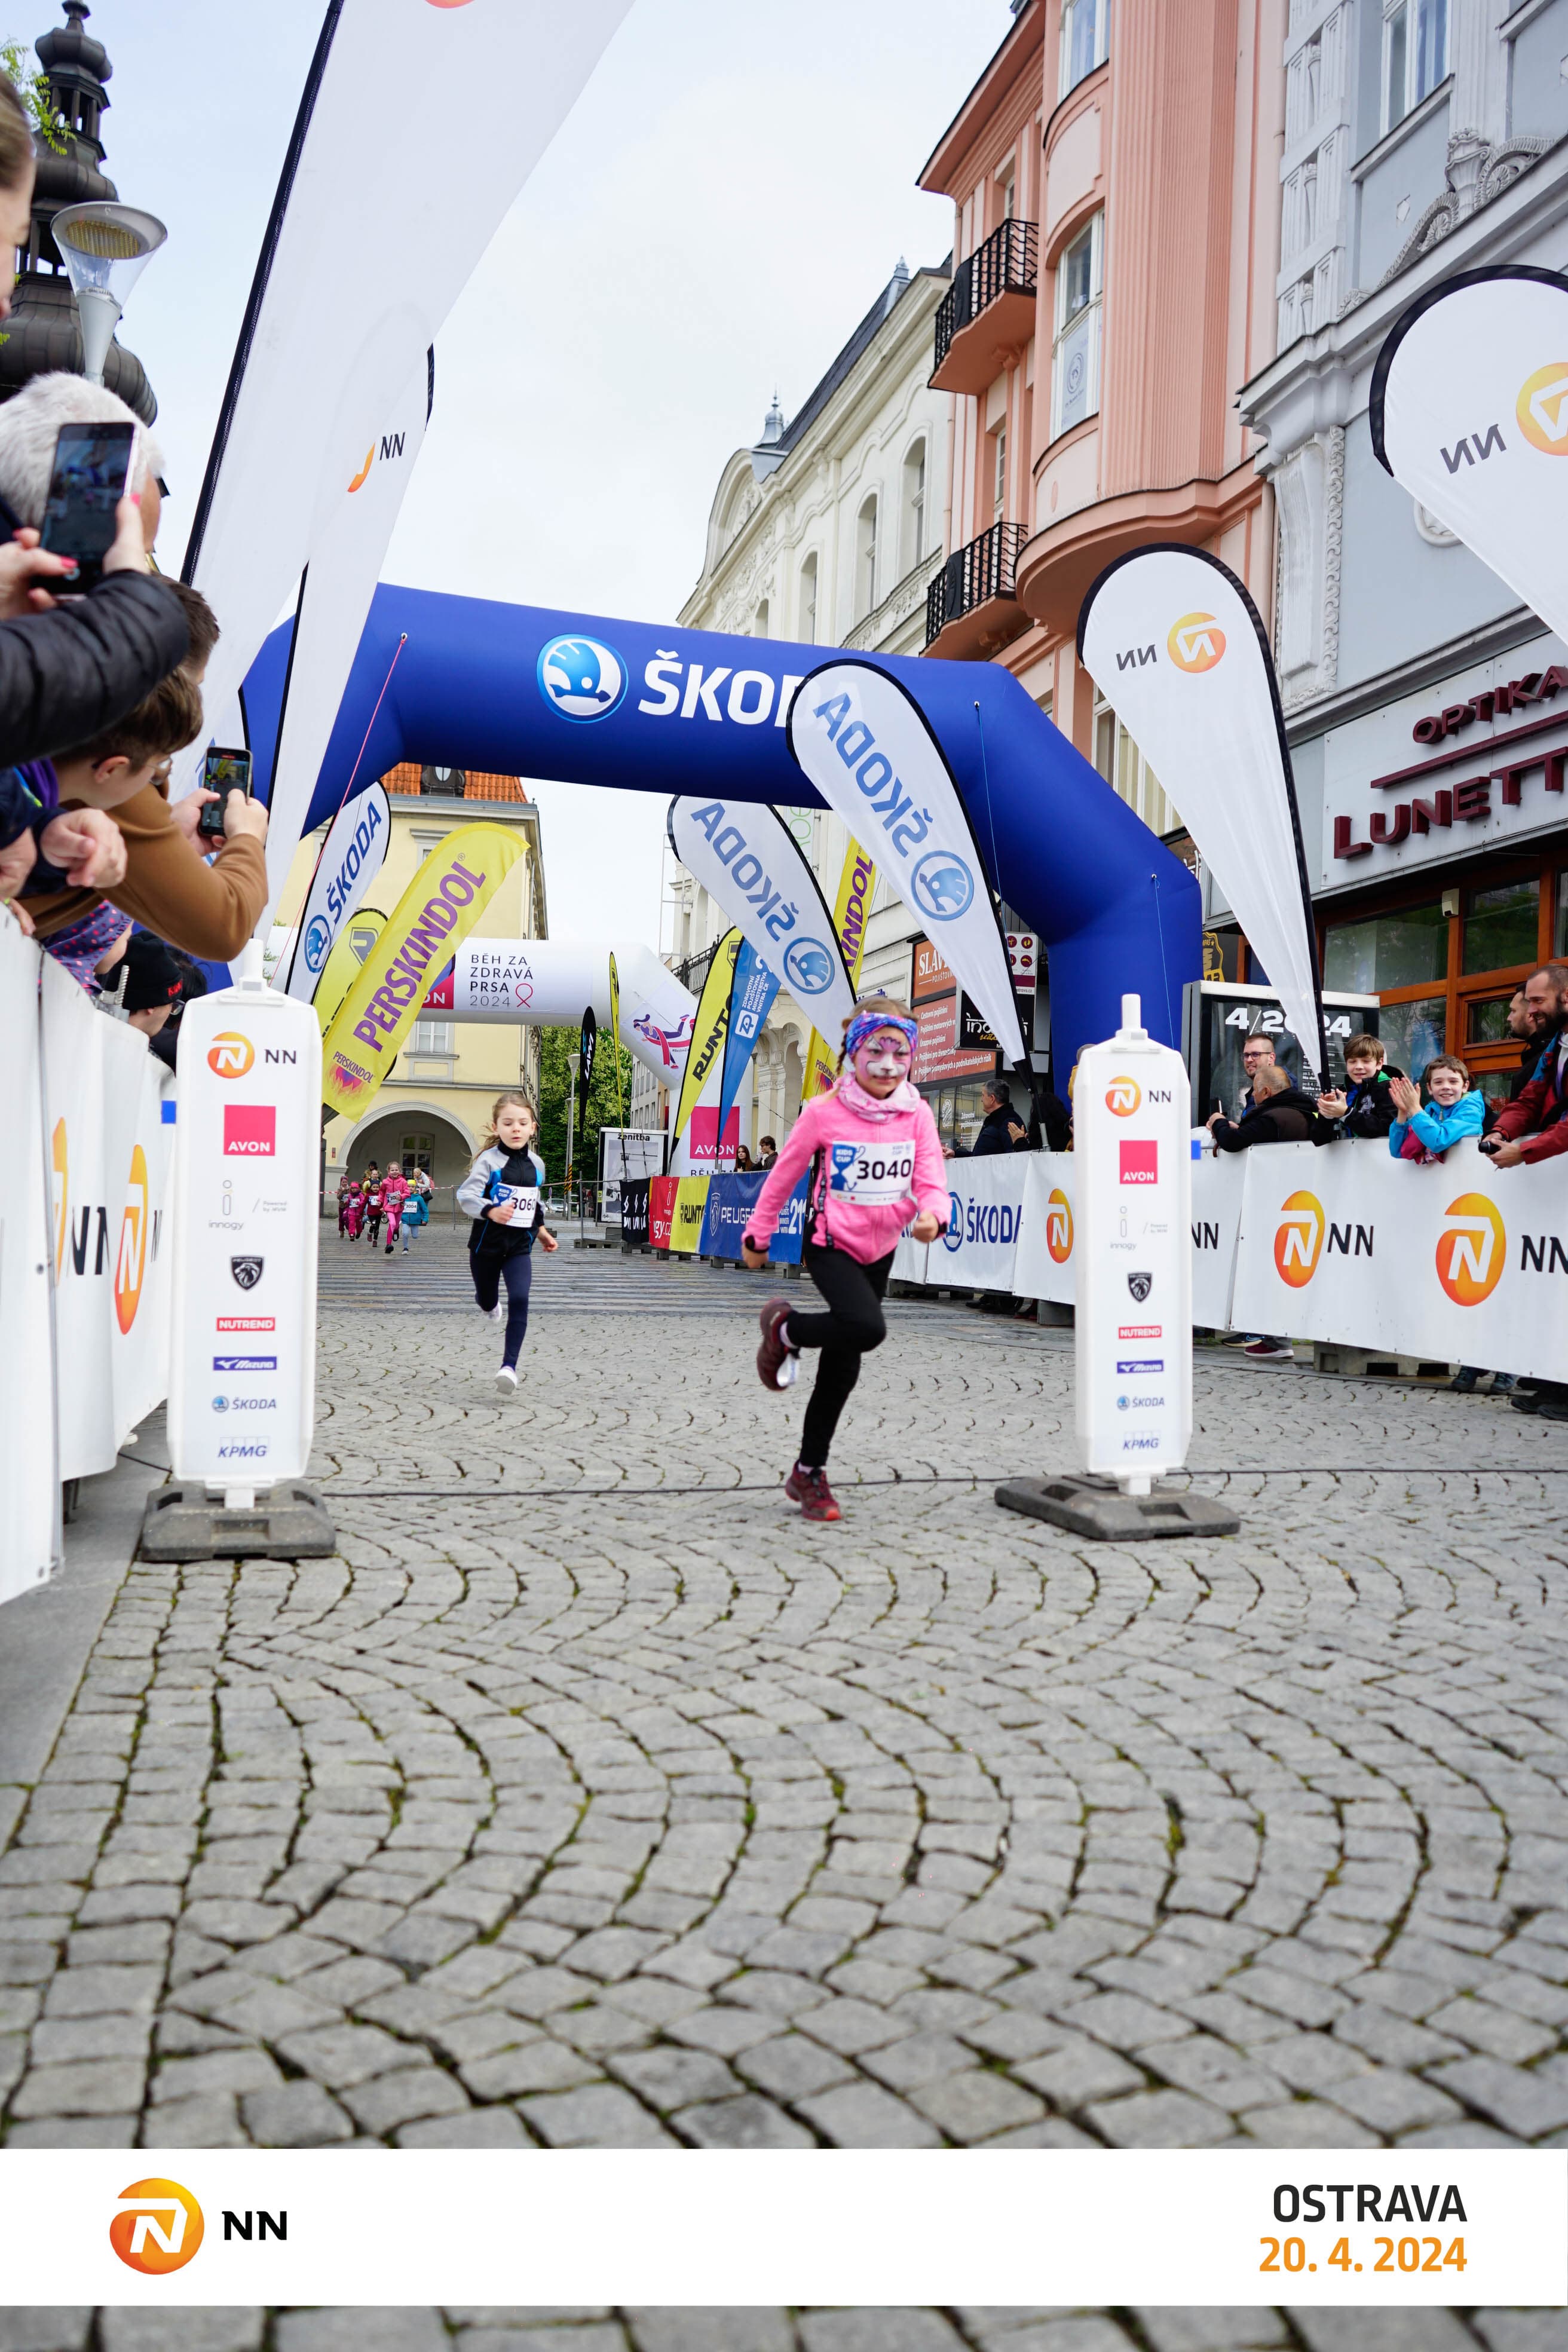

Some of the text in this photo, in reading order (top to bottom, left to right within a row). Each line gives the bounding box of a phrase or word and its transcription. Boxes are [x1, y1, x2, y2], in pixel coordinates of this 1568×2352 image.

[379, 431, 406, 461] NN
[637, 648, 804, 728] ŠKO
[1413, 665, 1568, 744] OPTIKA
[326, 801, 382, 924] ŠKODA
[353, 860, 486, 1053] PERSKINDOL
[471, 953, 528, 966] BĚH ZA
[470, 966, 533, 979] ZDRAVÁ
[470, 981, 509, 993] PRSA
[742, 975, 755, 1008] ZDRAVOTNÍ
[752, 972, 768, 1012] MINISTERSTVA
[470, 995, 510, 1007] 2024
[756, 992, 767, 1012] VNITRA
[264, 1049, 296, 1065] NN
[983, 1053, 991, 1062] rizik
[333, 1051, 373, 1084] PERSKINDOL
[815, 1059, 836, 1083] PERSKINDO
[1148, 1090, 1171, 1103] NN
[228, 1141, 271, 1153] AVON
[694, 1145, 734, 1154] AVON
[856, 1159, 912, 1180] 3040
[1123, 1171, 1154, 1181] AVON
[512, 1197, 536, 1211] 3060
[721, 1206, 755, 1224] PEUGE
[209, 1220, 244, 1230] innogy
[1110, 1242, 1137, 1250] innogy
[1327, 1223, 1374, 1257] NN
[1521, 1234, 1568, 1275] NN
[219, 1319, 274, 1330] NUTREND
[1119, 1328, 1161, 1338] NUTREND
[231, 1396, 277, 1410] ŠKODA
[1132, 1396, 1165, 1408] ŠKODA
[218, 1445, 268, 1458] KPMG
[1123, 1438, 1160, 1451] KPMG
